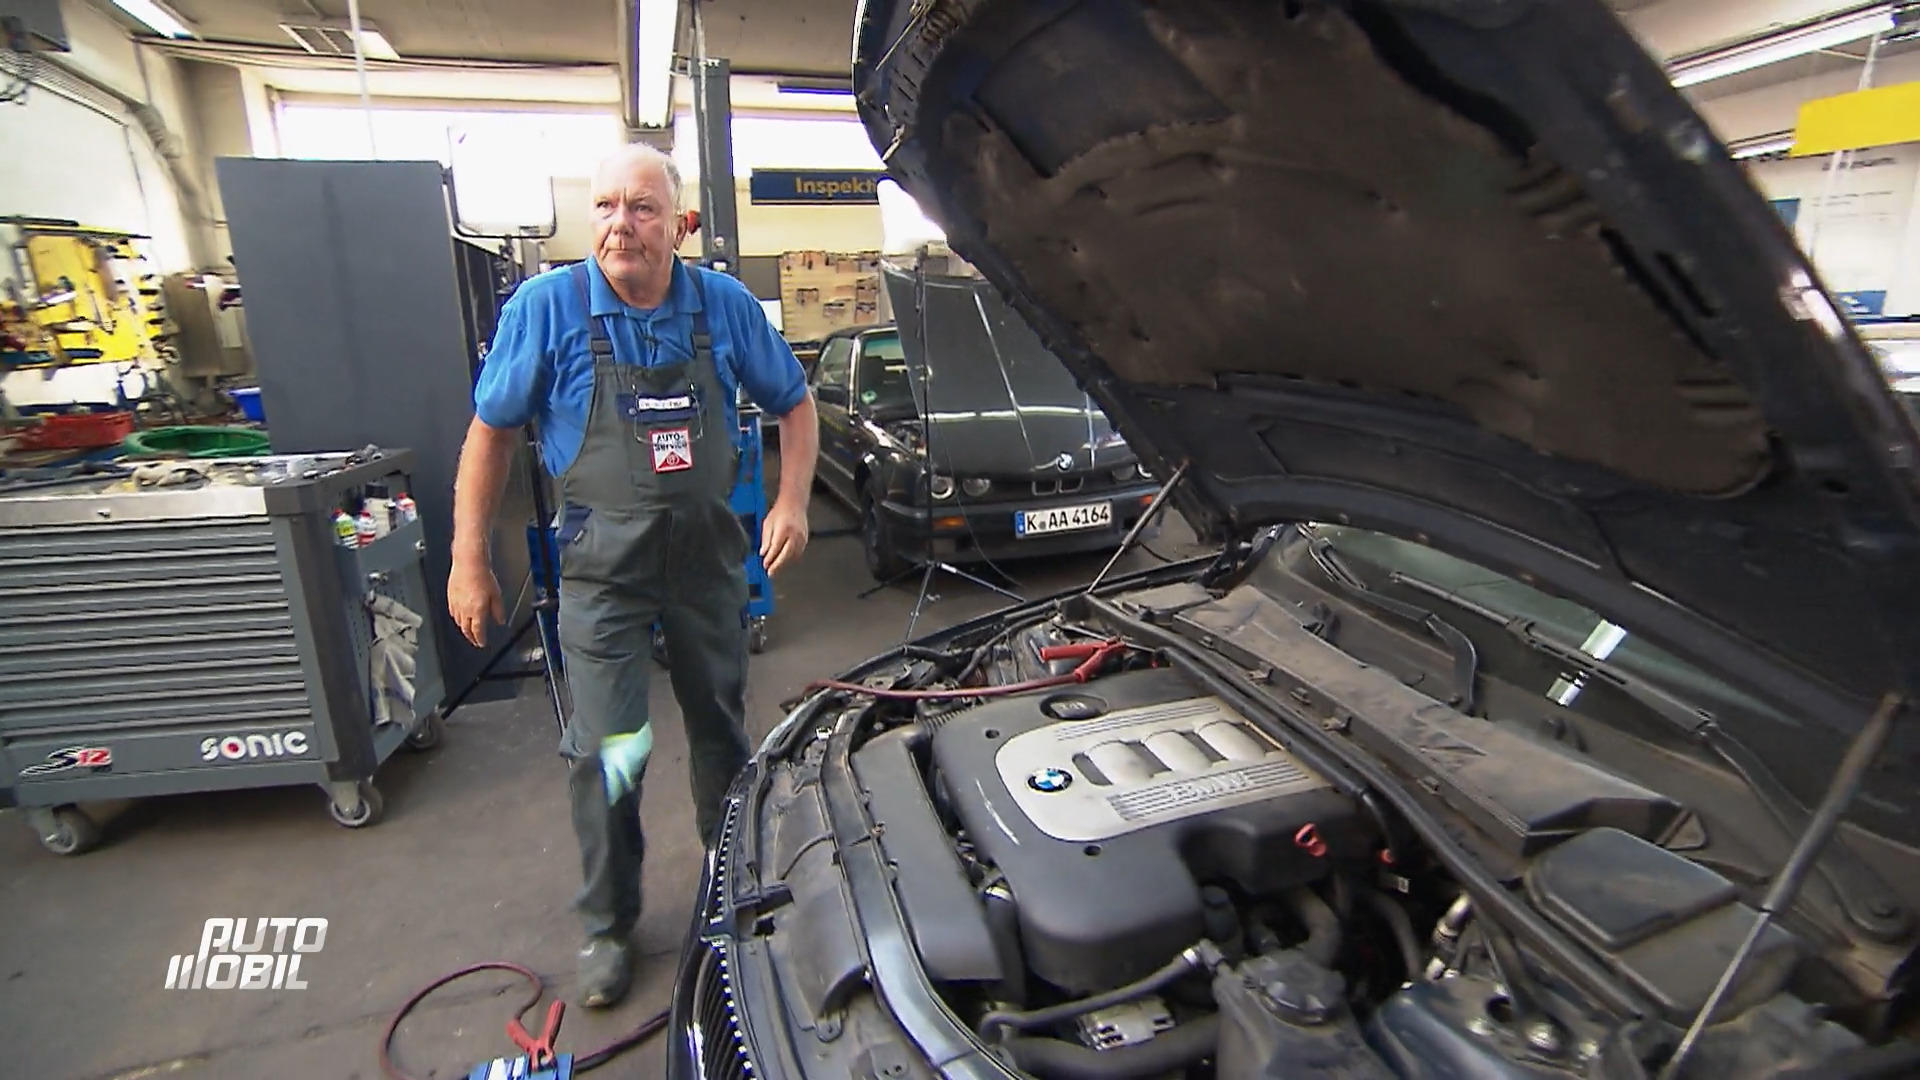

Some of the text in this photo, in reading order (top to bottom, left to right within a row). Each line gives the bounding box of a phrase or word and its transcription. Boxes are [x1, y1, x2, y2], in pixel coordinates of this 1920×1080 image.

[1026, 505, 1108, 531] K AA 4164
